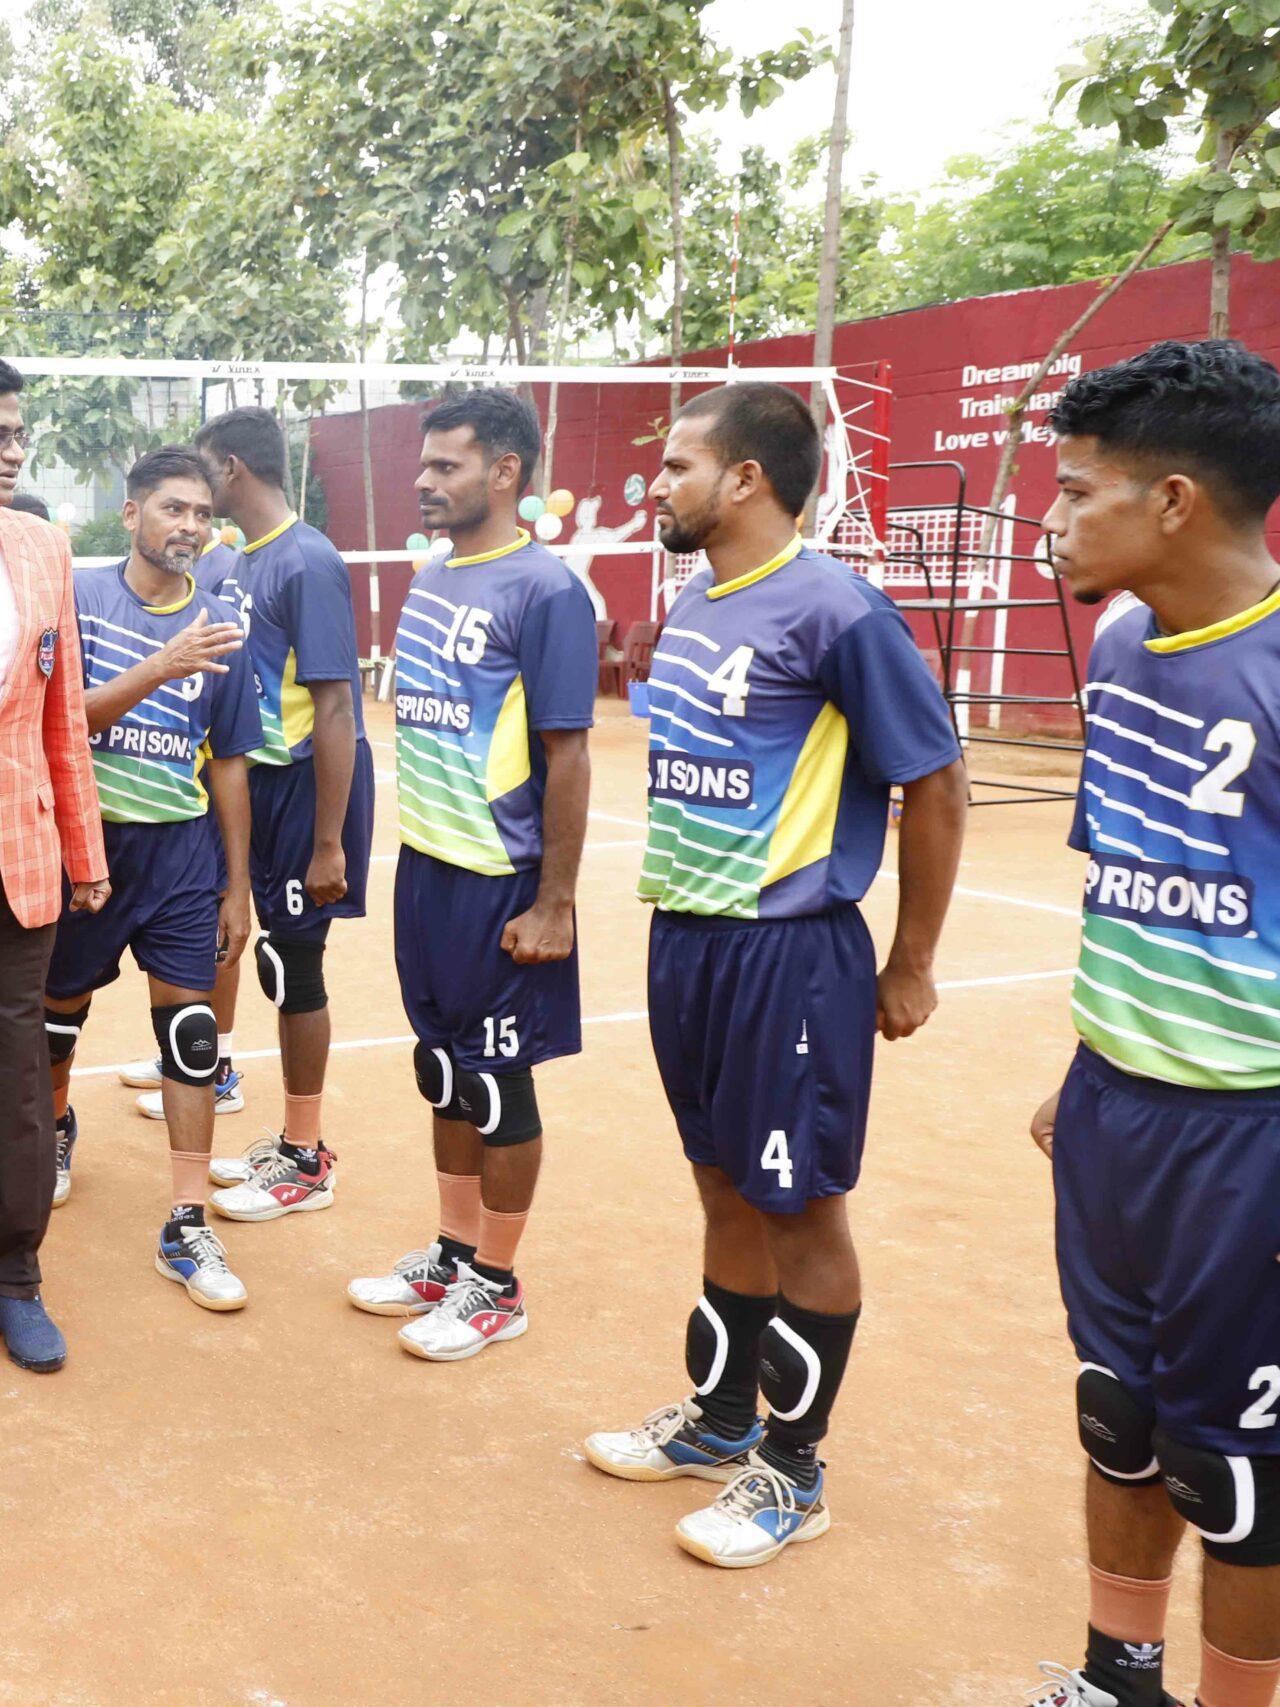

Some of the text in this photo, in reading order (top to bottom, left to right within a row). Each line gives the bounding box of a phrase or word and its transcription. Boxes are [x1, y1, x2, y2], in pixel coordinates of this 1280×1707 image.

[961, 362, 1041, 388] Dream
[934, 430, 989, 451] Love
[442, 604, 494, 665] 15
[707, 645, 755, 717] 4
[1189, 718, 1257, 818] 2
[286, 879, 304, 916] 6
[483, 1015, 520, 1058] 15
[760, 1130, 793, 1188] 4
[1238, 1365, 1280, 1429] 2
